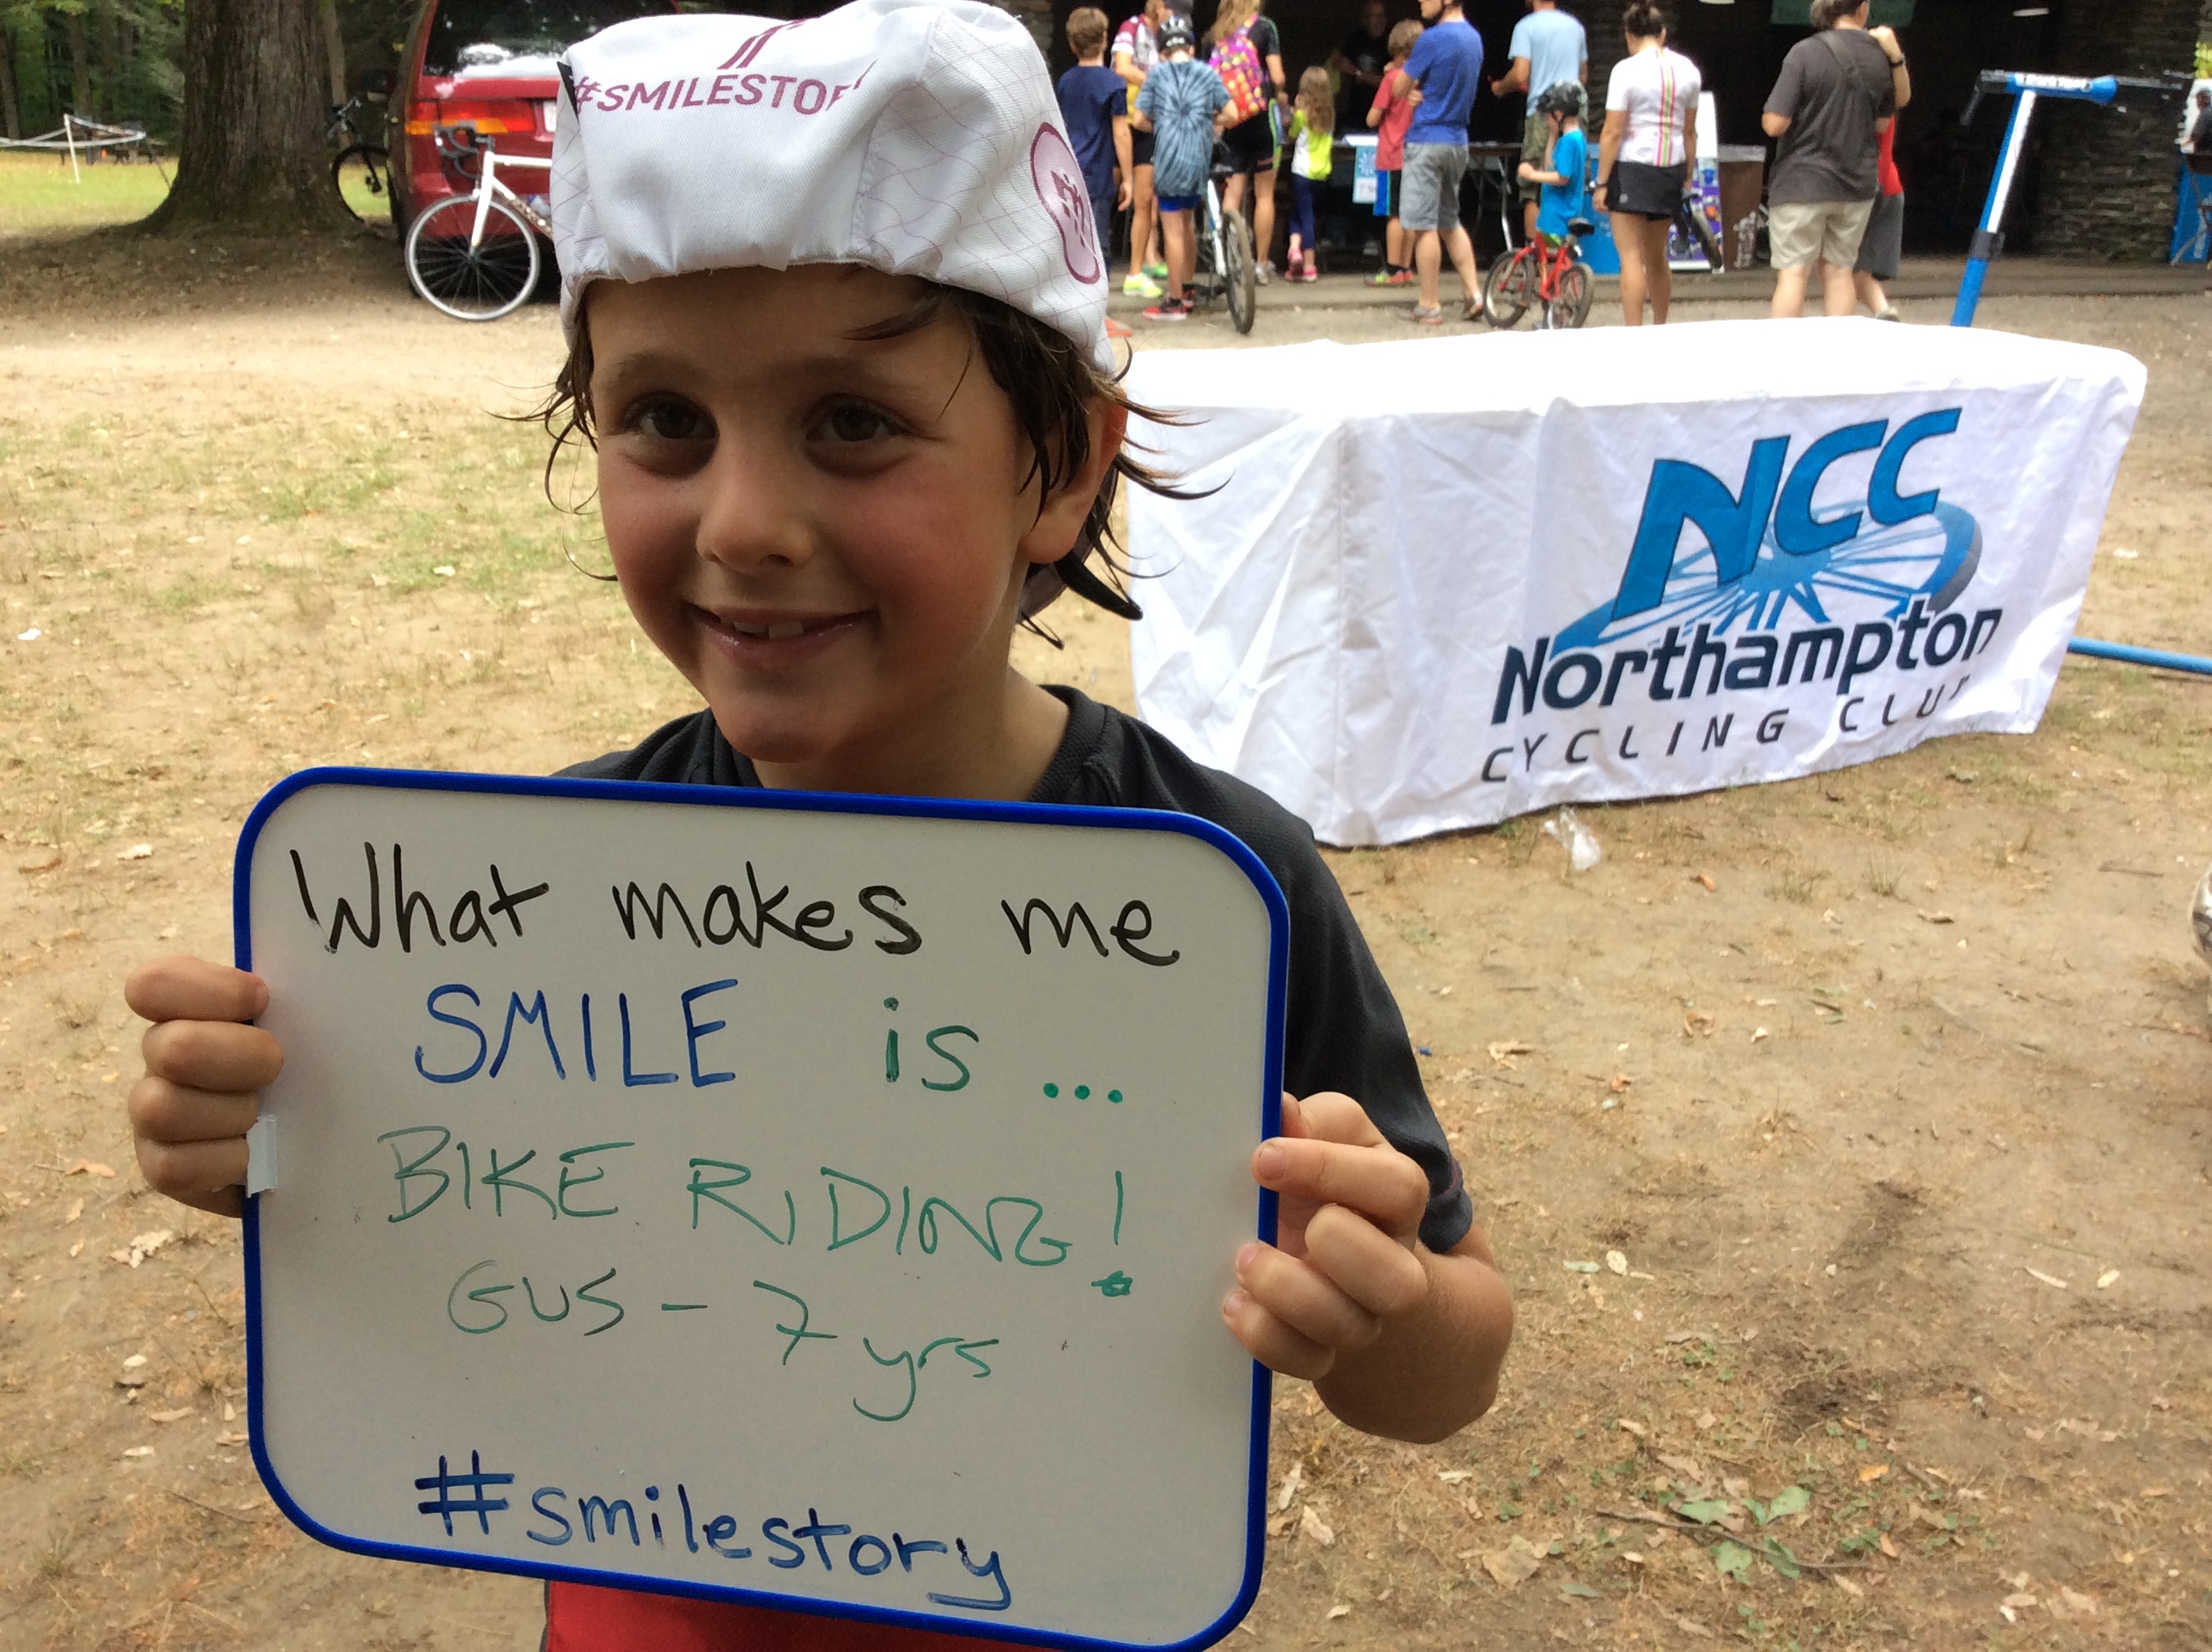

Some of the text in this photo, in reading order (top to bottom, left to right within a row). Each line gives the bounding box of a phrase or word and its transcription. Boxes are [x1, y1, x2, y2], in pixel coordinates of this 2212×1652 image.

[575, 59, 877, 116] #SMILESTO
[1610, 407, 1962, 621] NCC
[1491, 599, 2002, 724] Northampton
[1481, 708, 1789, 782] CYCLING
[289, 841, 1181, 968] What makes me
[415, 979, 738, 1088] SMILE
[883, 997, 979, 1091] is
[377, 1126, 636, 1224] BIKE
[445, 1259, 626, 1338] GUS
[753, 1280, 838, 1366] 7
[853, 1335, 1002, 1422] yrs
[415, 1450, 1013, 1611] #smilestory
